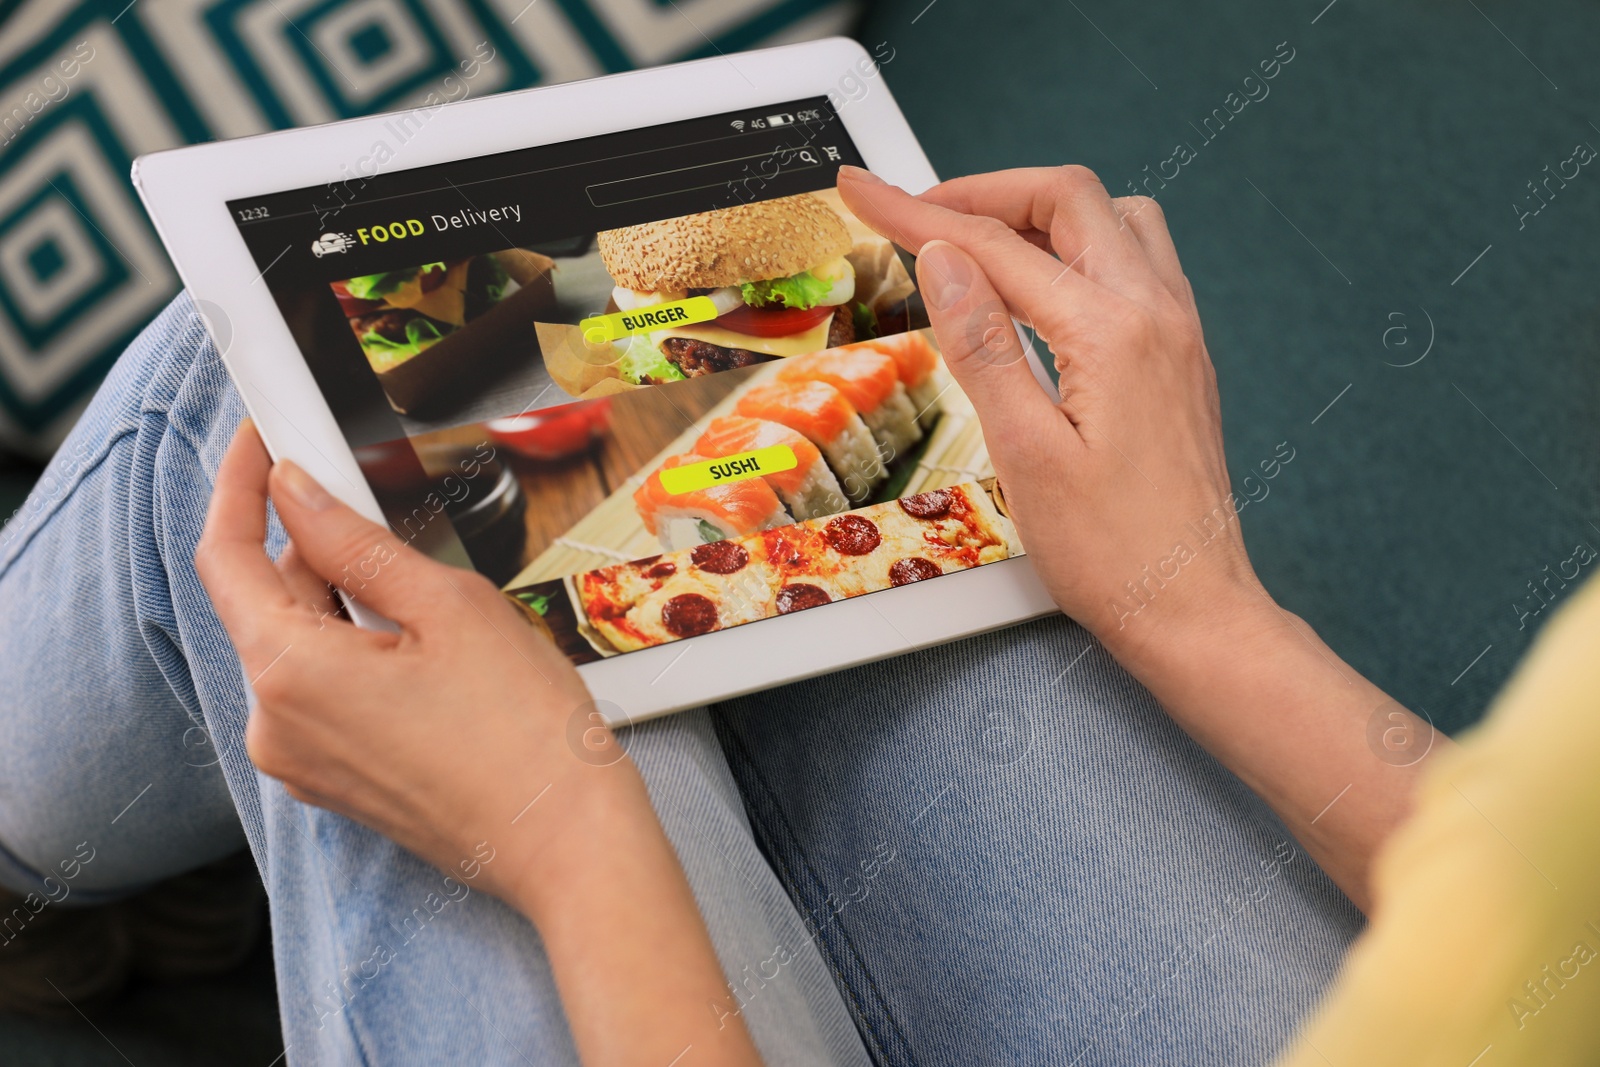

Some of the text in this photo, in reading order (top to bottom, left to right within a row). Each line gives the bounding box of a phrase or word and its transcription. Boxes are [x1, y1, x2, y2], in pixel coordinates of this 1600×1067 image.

[751, 118, 766, 129] 4G
[238, 206, 270, 221] 12:32
[357, 204, 521, 246] FOOD Delivery
[622, 306, 688, 331] BURGER
[709, 457, 760, 480] SUSHI
